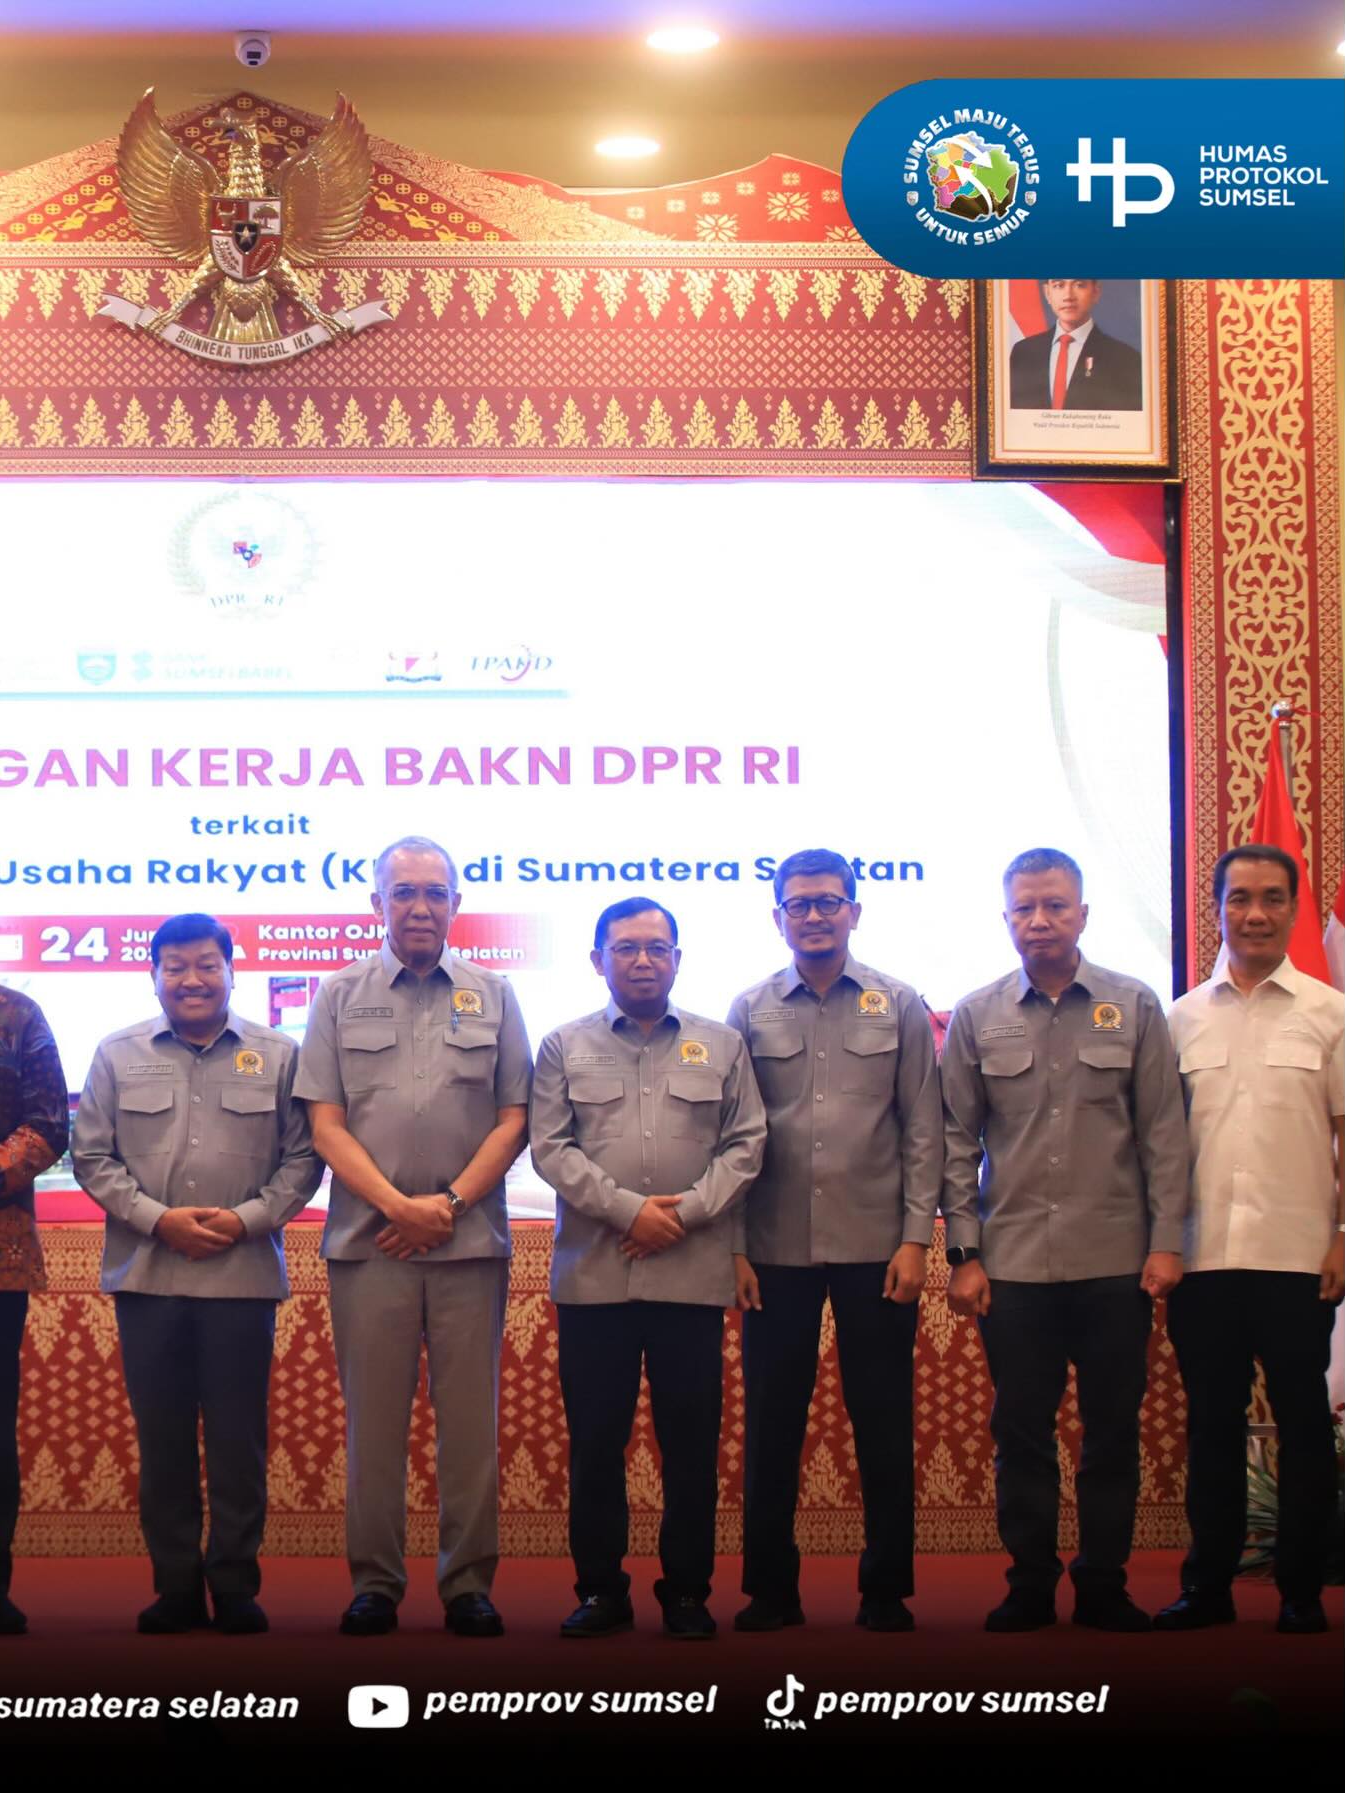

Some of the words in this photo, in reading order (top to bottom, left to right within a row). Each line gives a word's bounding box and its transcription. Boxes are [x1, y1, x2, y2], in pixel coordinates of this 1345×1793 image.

[175, 330, 232, 359] BHINNEKA
[237, 342, 290, 360] TUNGGAL
[292, 332, 314, 350] IKA
[151, 747, 365, 787] KERJA
[385, 746, 571, 786] BAKN
[593, 745, 722, 785] DPR
[743, 745, 800, 785] RI
[190, 812, 310, 836] terkait
[147, 857, 307, 893] Rakyat
[462, 855, 503, 883] di
[517, 857, 740, 883] Sumatera
[754, 856, 924, 882] Stan
[40, 926, 109, 962] 24
[258, 924, 339, 940] Kantor
[258, 945, 337, 961] Provinsi
[451, 946, 525, 960] Selatan
